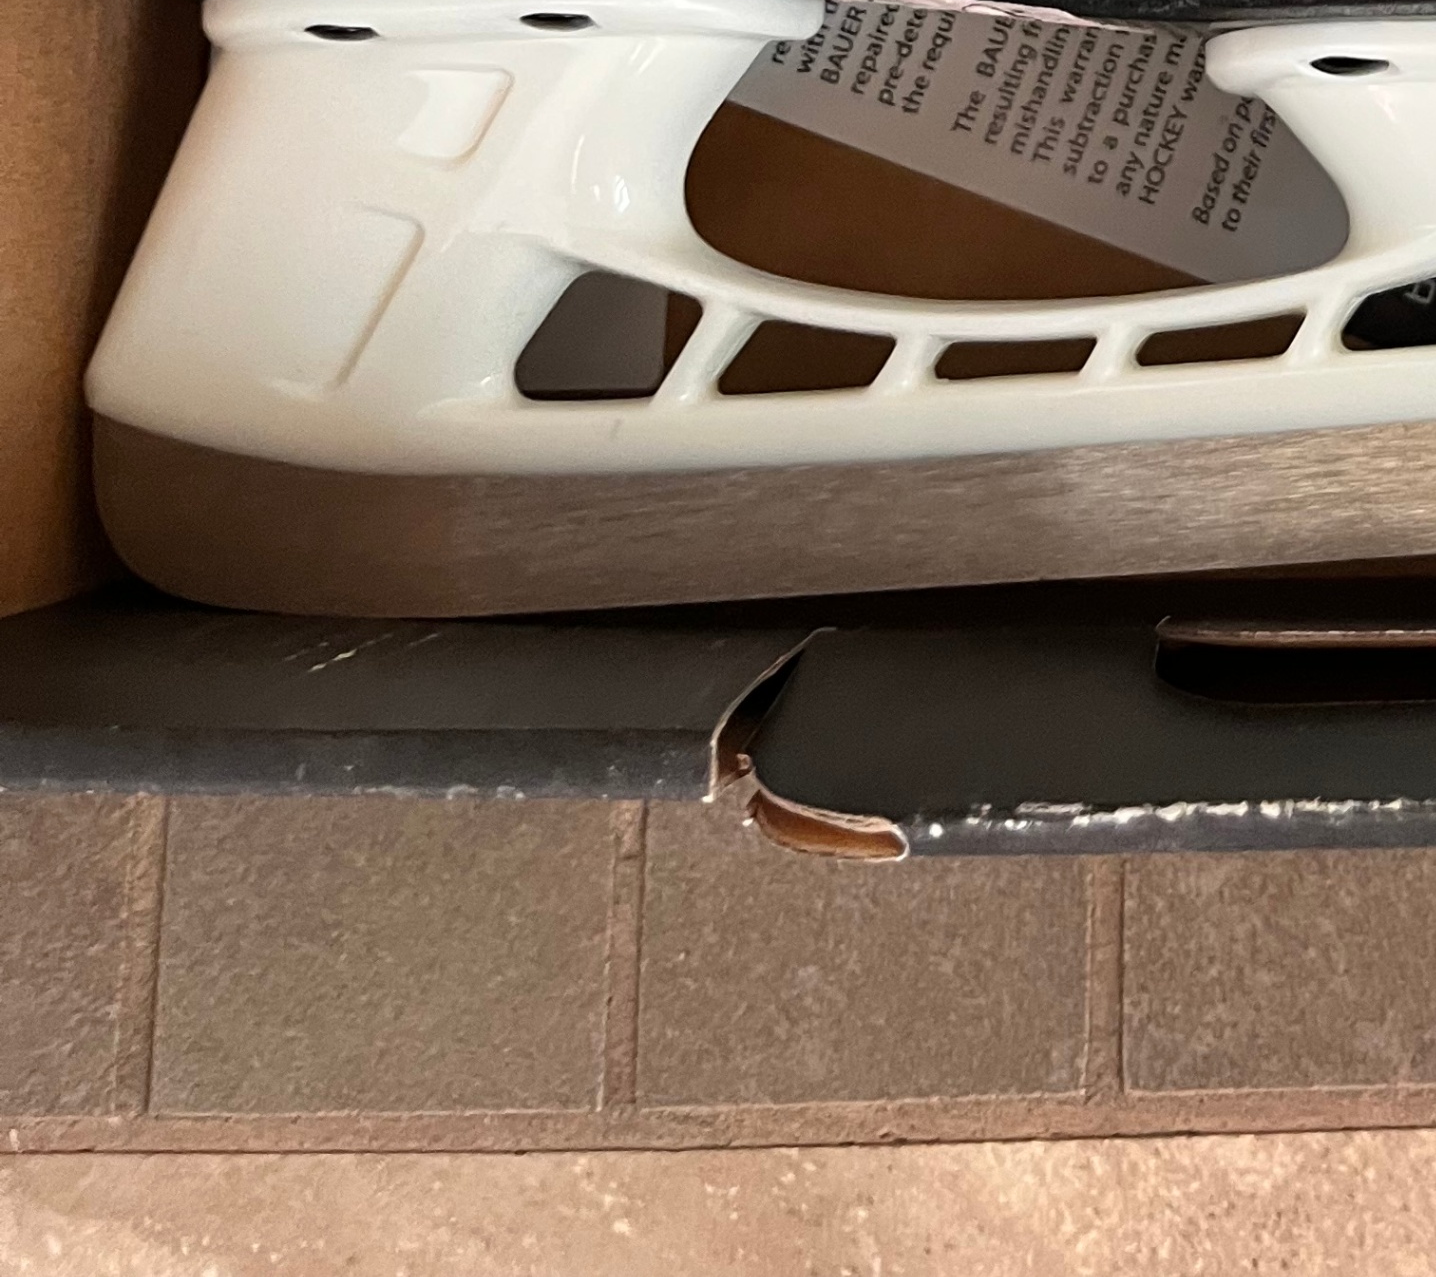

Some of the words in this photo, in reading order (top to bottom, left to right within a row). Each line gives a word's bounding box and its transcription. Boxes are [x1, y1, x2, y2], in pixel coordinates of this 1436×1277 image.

[818, 5, 867, 85] BAUER
[900, 75, 930, 114] the
[949, 89, 987, 132] The
[982, 42, 1038, 145] resulting
[1062, 42, 1125, 175] subtraction
[1029, 116, 1066, 162] This
[1086, 159, 1109, 184] to
[1102, 135, 1118, 150] a
[1114, 150, 1145, 197] any
[1133, 70, 1173, 147] nature
[1136, 103, 1188, 205] HOCKEY
[1190, 151, 1230, 226] Based
[1221, 122, 1244, 154] on
[1230, 149, 1262, 204] their
[1220, 207, 1241, 232] to
